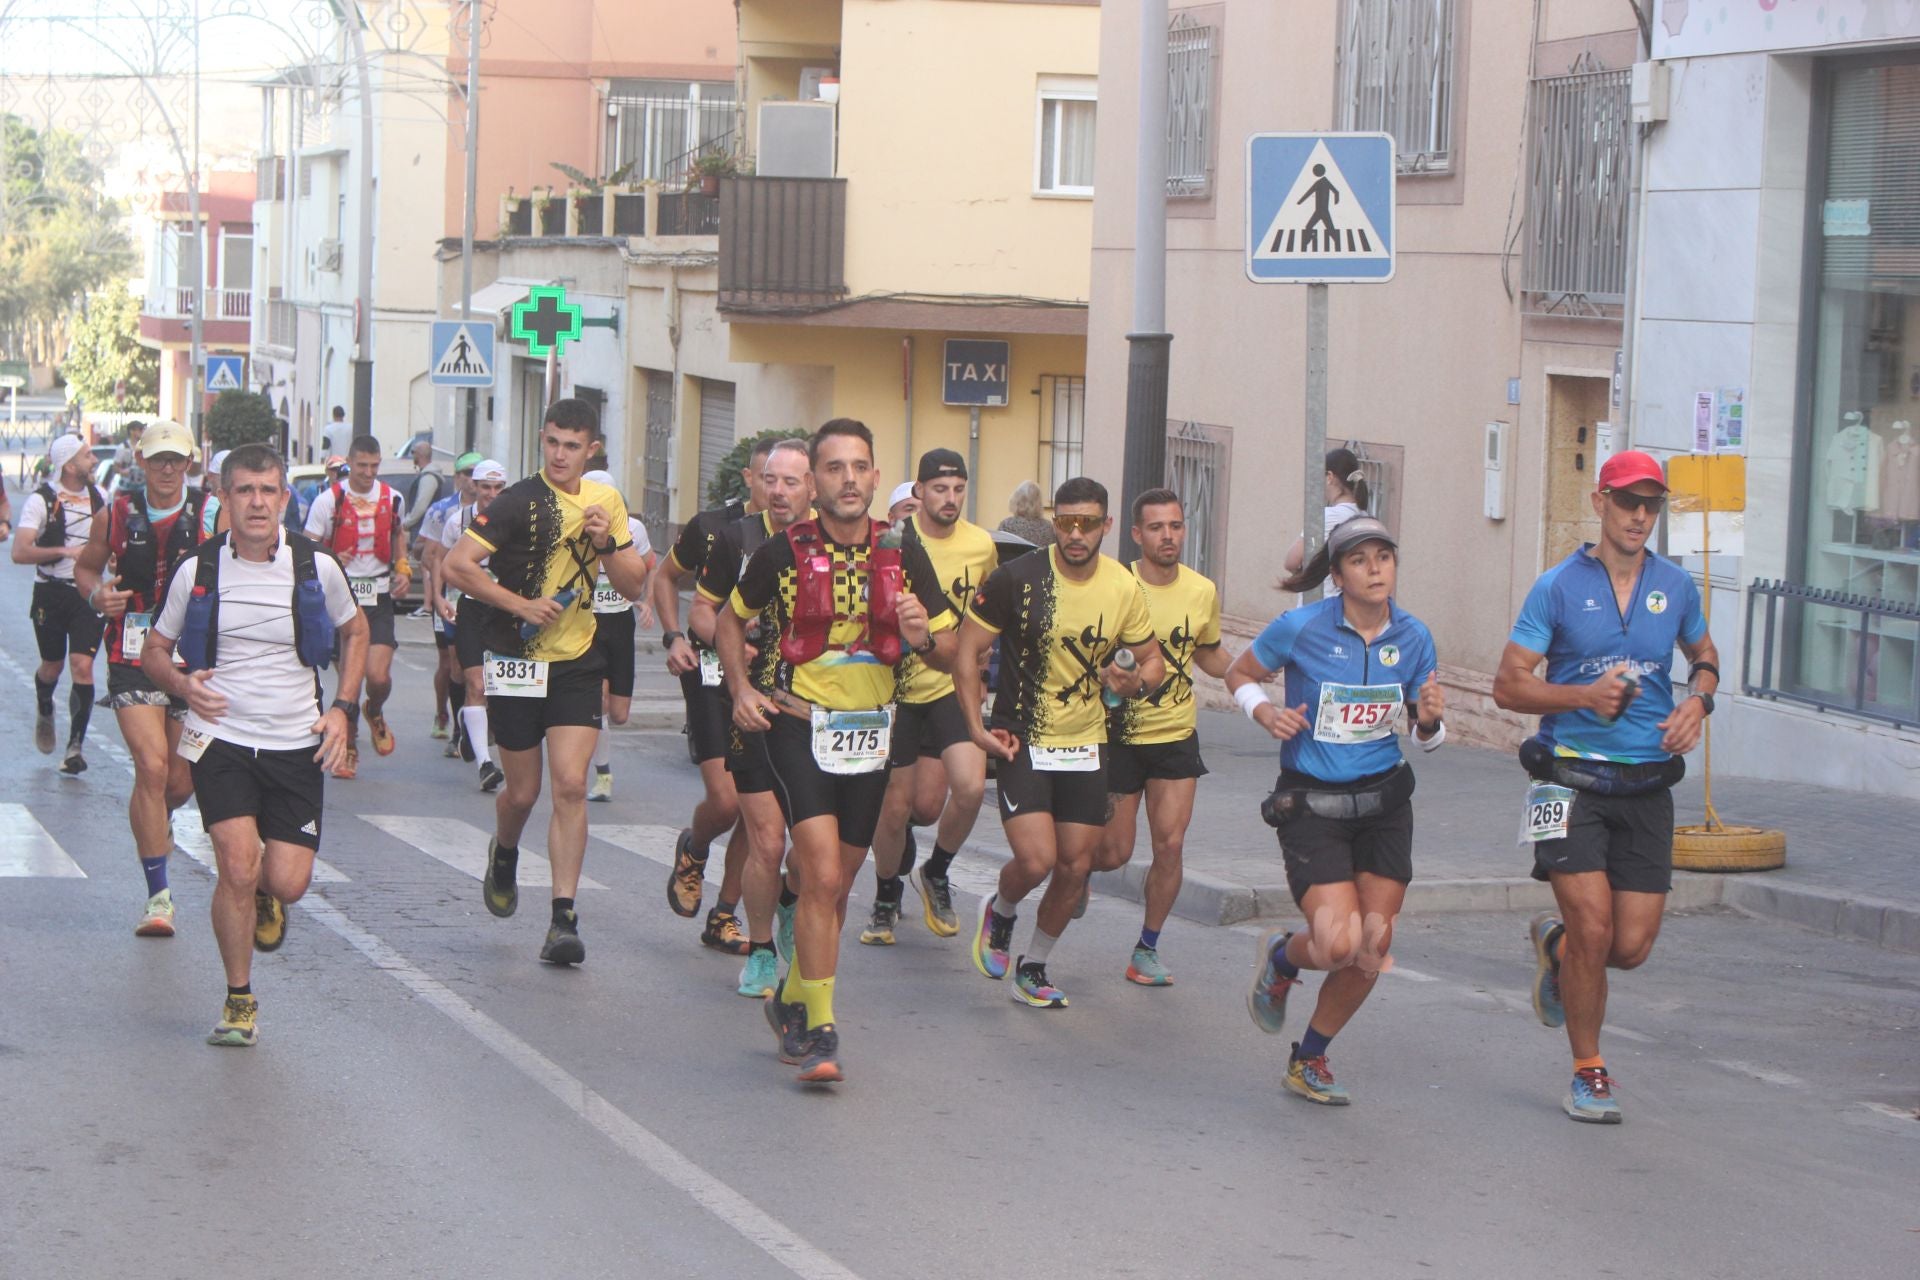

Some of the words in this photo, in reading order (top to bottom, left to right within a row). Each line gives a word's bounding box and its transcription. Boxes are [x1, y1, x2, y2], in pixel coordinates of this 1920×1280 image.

[947, 362, 1006, 382] TAXI
[496, 661, 536, 679] 3831
[1340, 703, 1392, 725] 1257
[831, 729, 879, 752] 2175
